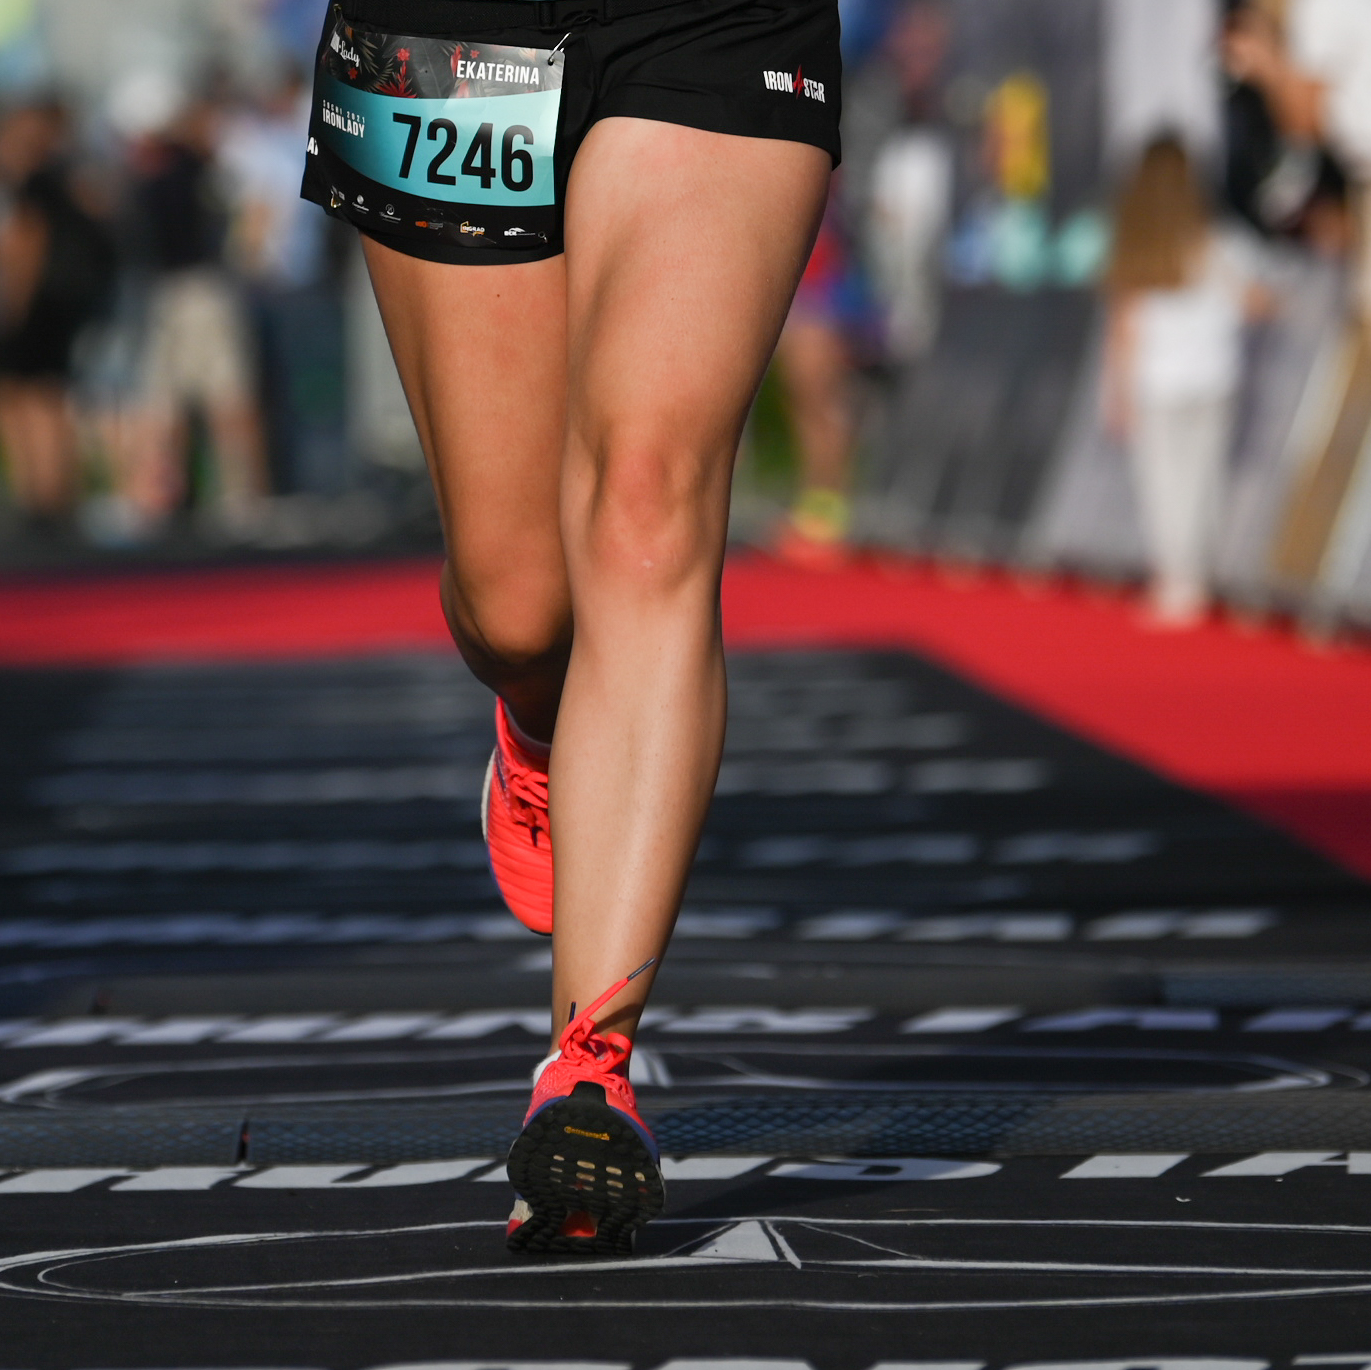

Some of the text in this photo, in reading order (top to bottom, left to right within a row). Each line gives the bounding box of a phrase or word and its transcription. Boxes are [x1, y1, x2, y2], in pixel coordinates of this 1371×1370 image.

[456, 60, 540, 85] EKATERINA
[763, 70, 793, 93] IRON
[322, 107, 365, 138] IRONLADY
[346, 111, 365, 124] 2021
[392, 112, 534, 192] 7246
